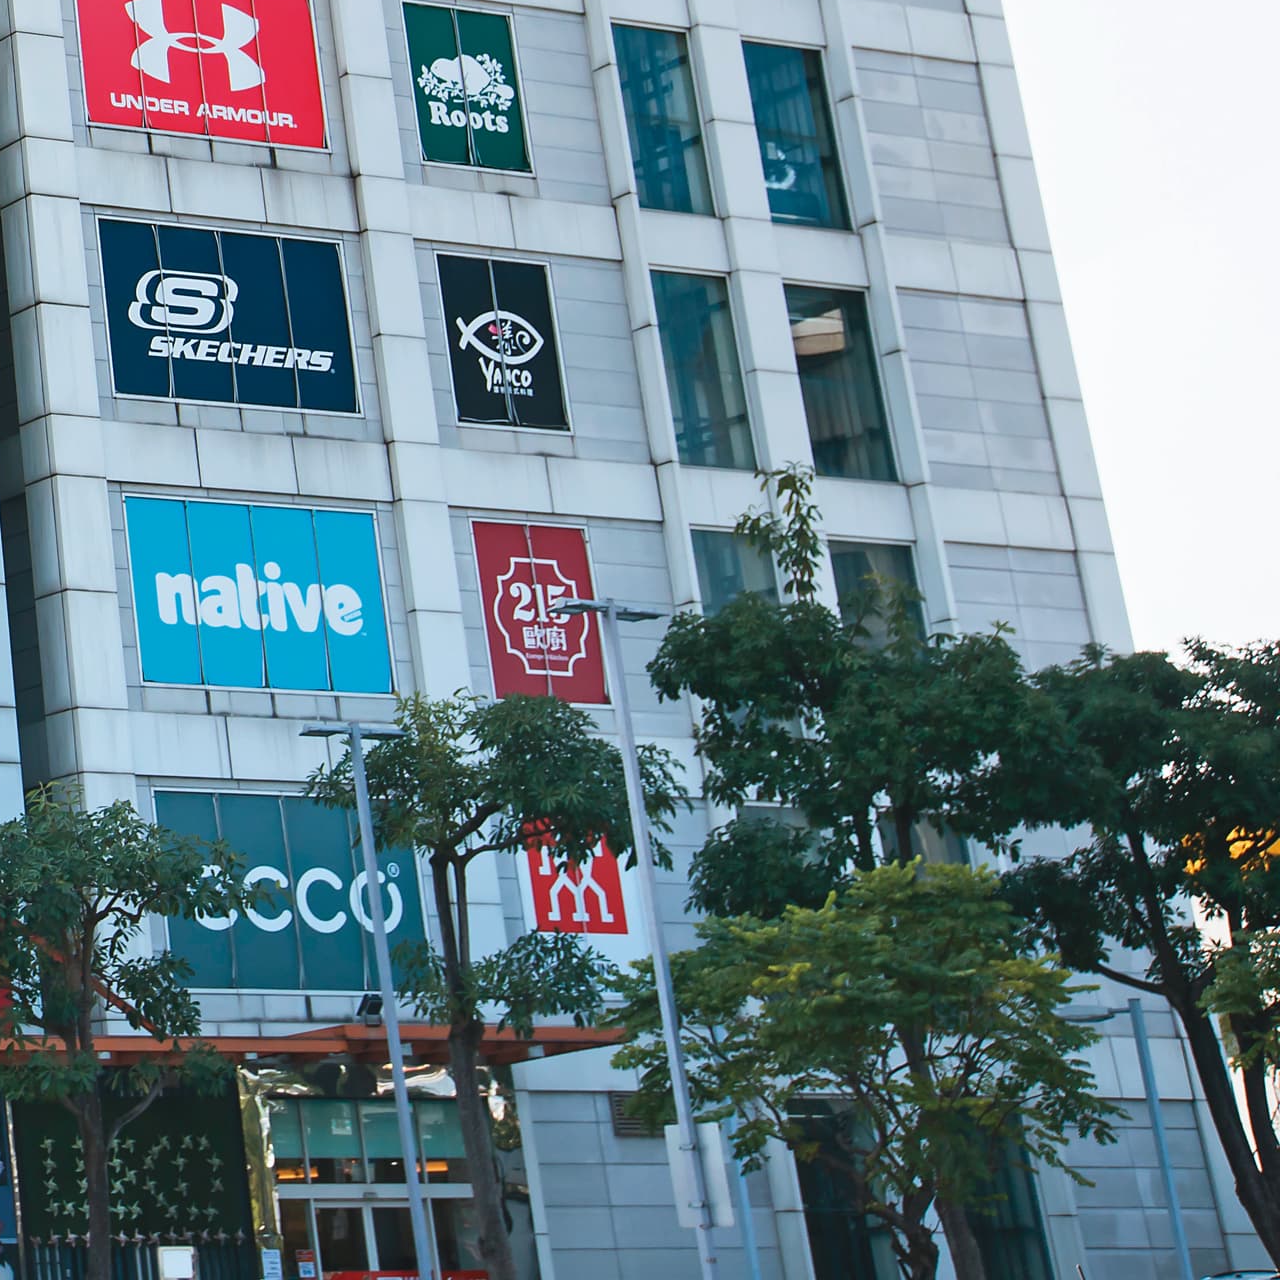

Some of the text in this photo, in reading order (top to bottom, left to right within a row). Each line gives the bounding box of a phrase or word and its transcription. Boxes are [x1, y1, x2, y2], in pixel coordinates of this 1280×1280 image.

[110, 91, 190, 117] UNDER
[429, 99, 510, 134] Roots
[147, 334, 334, 372] SKECHERS
[155, 561, 364, 636] native
[509, 582, 571, 624] 215
